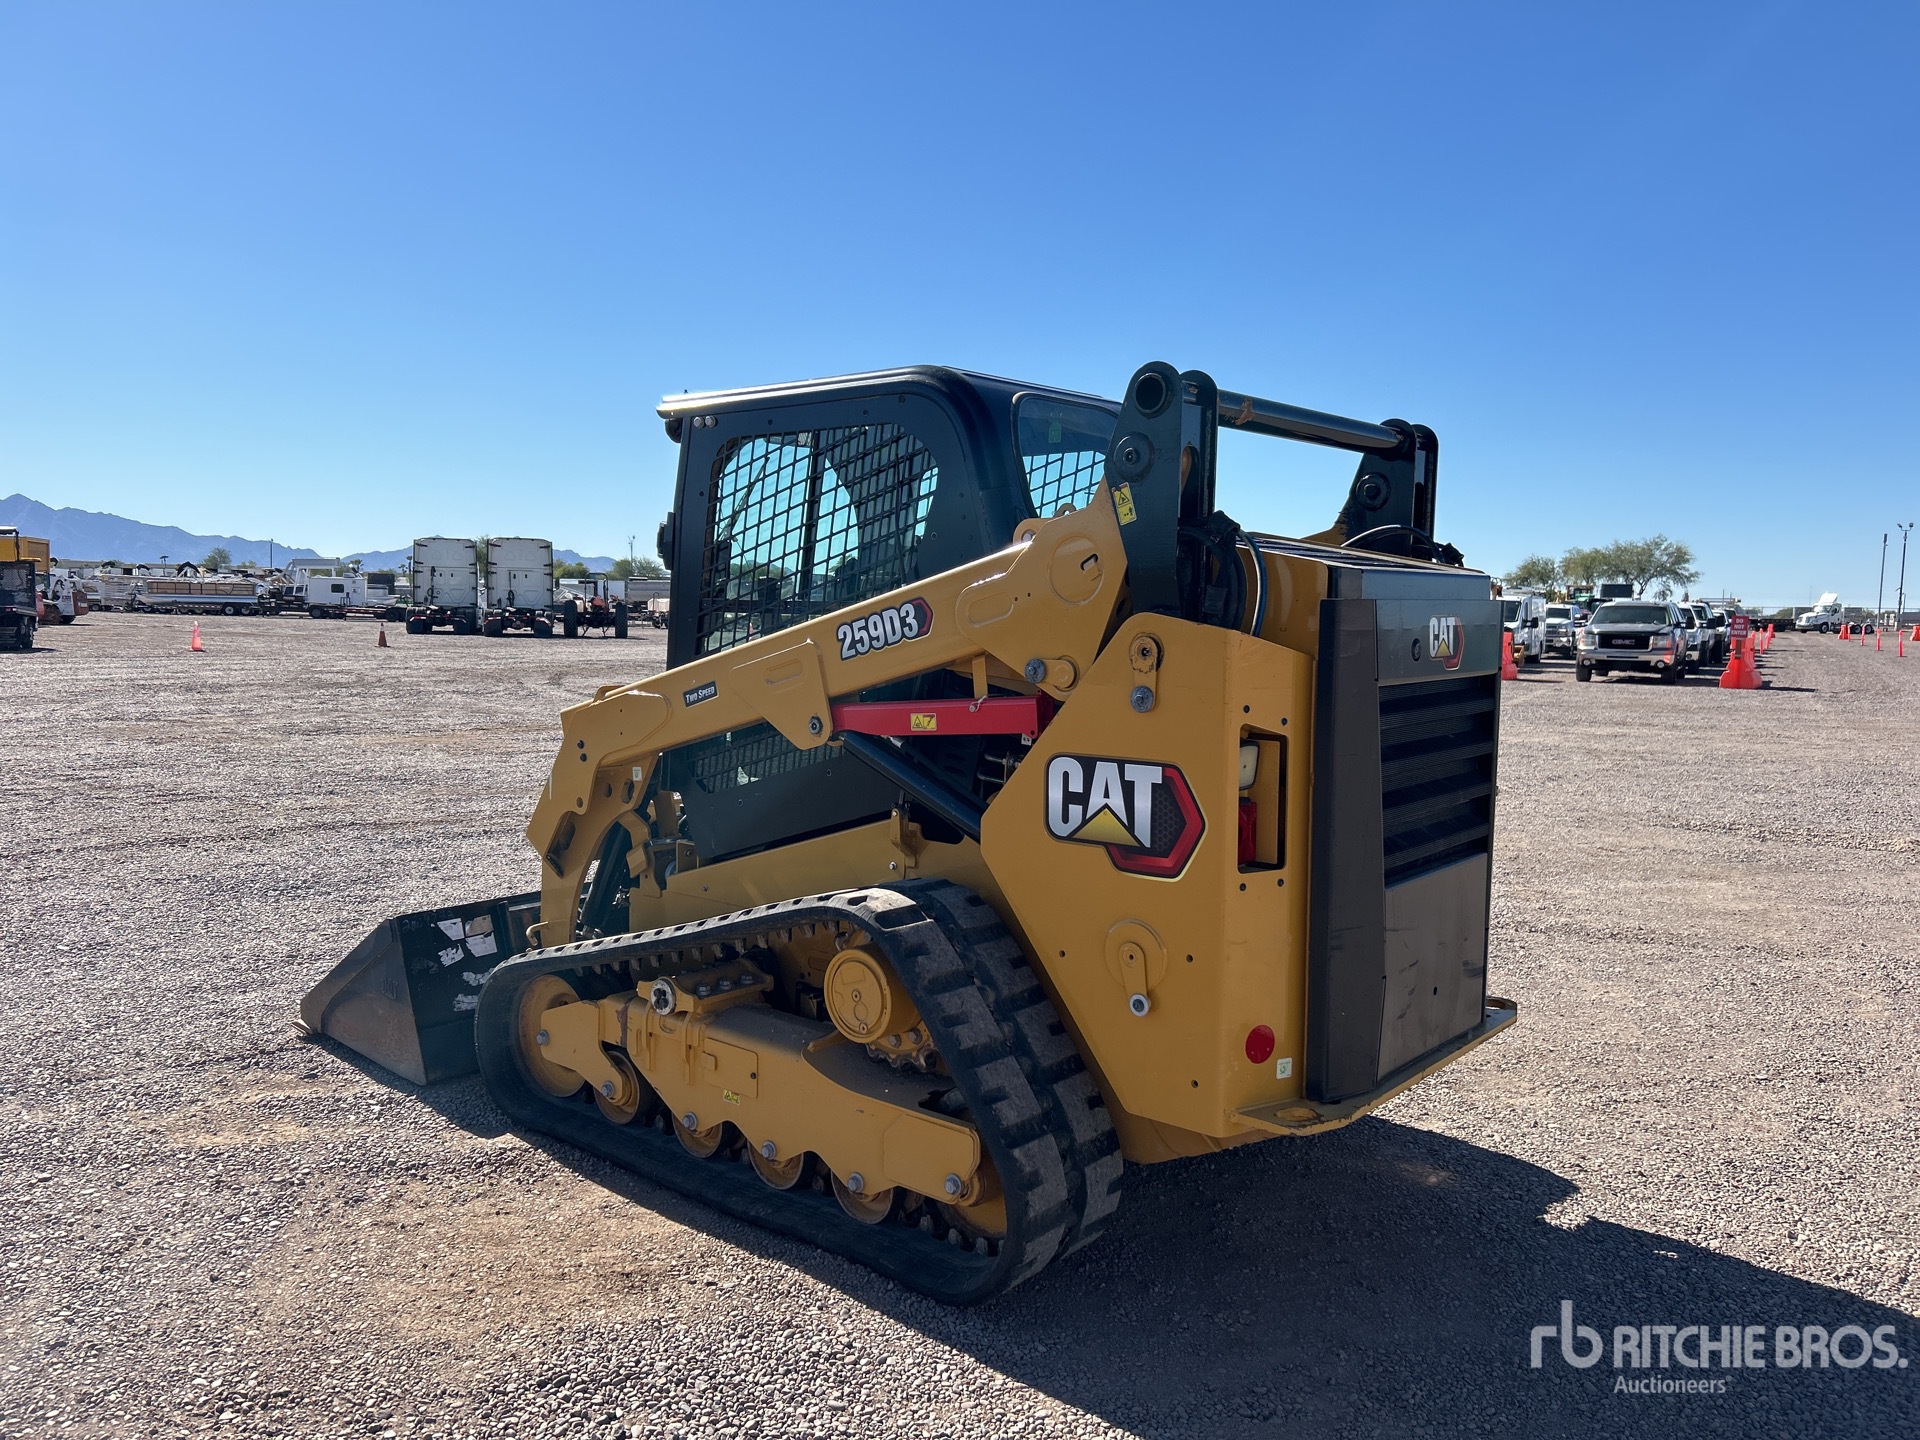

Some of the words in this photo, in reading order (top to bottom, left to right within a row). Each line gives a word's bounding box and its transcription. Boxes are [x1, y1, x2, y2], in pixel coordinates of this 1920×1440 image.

[838, 601, 918, 661] 259D3
[1429, 616, 1456, 658] CAT
[1048, 756, 1163, 848] CAT
